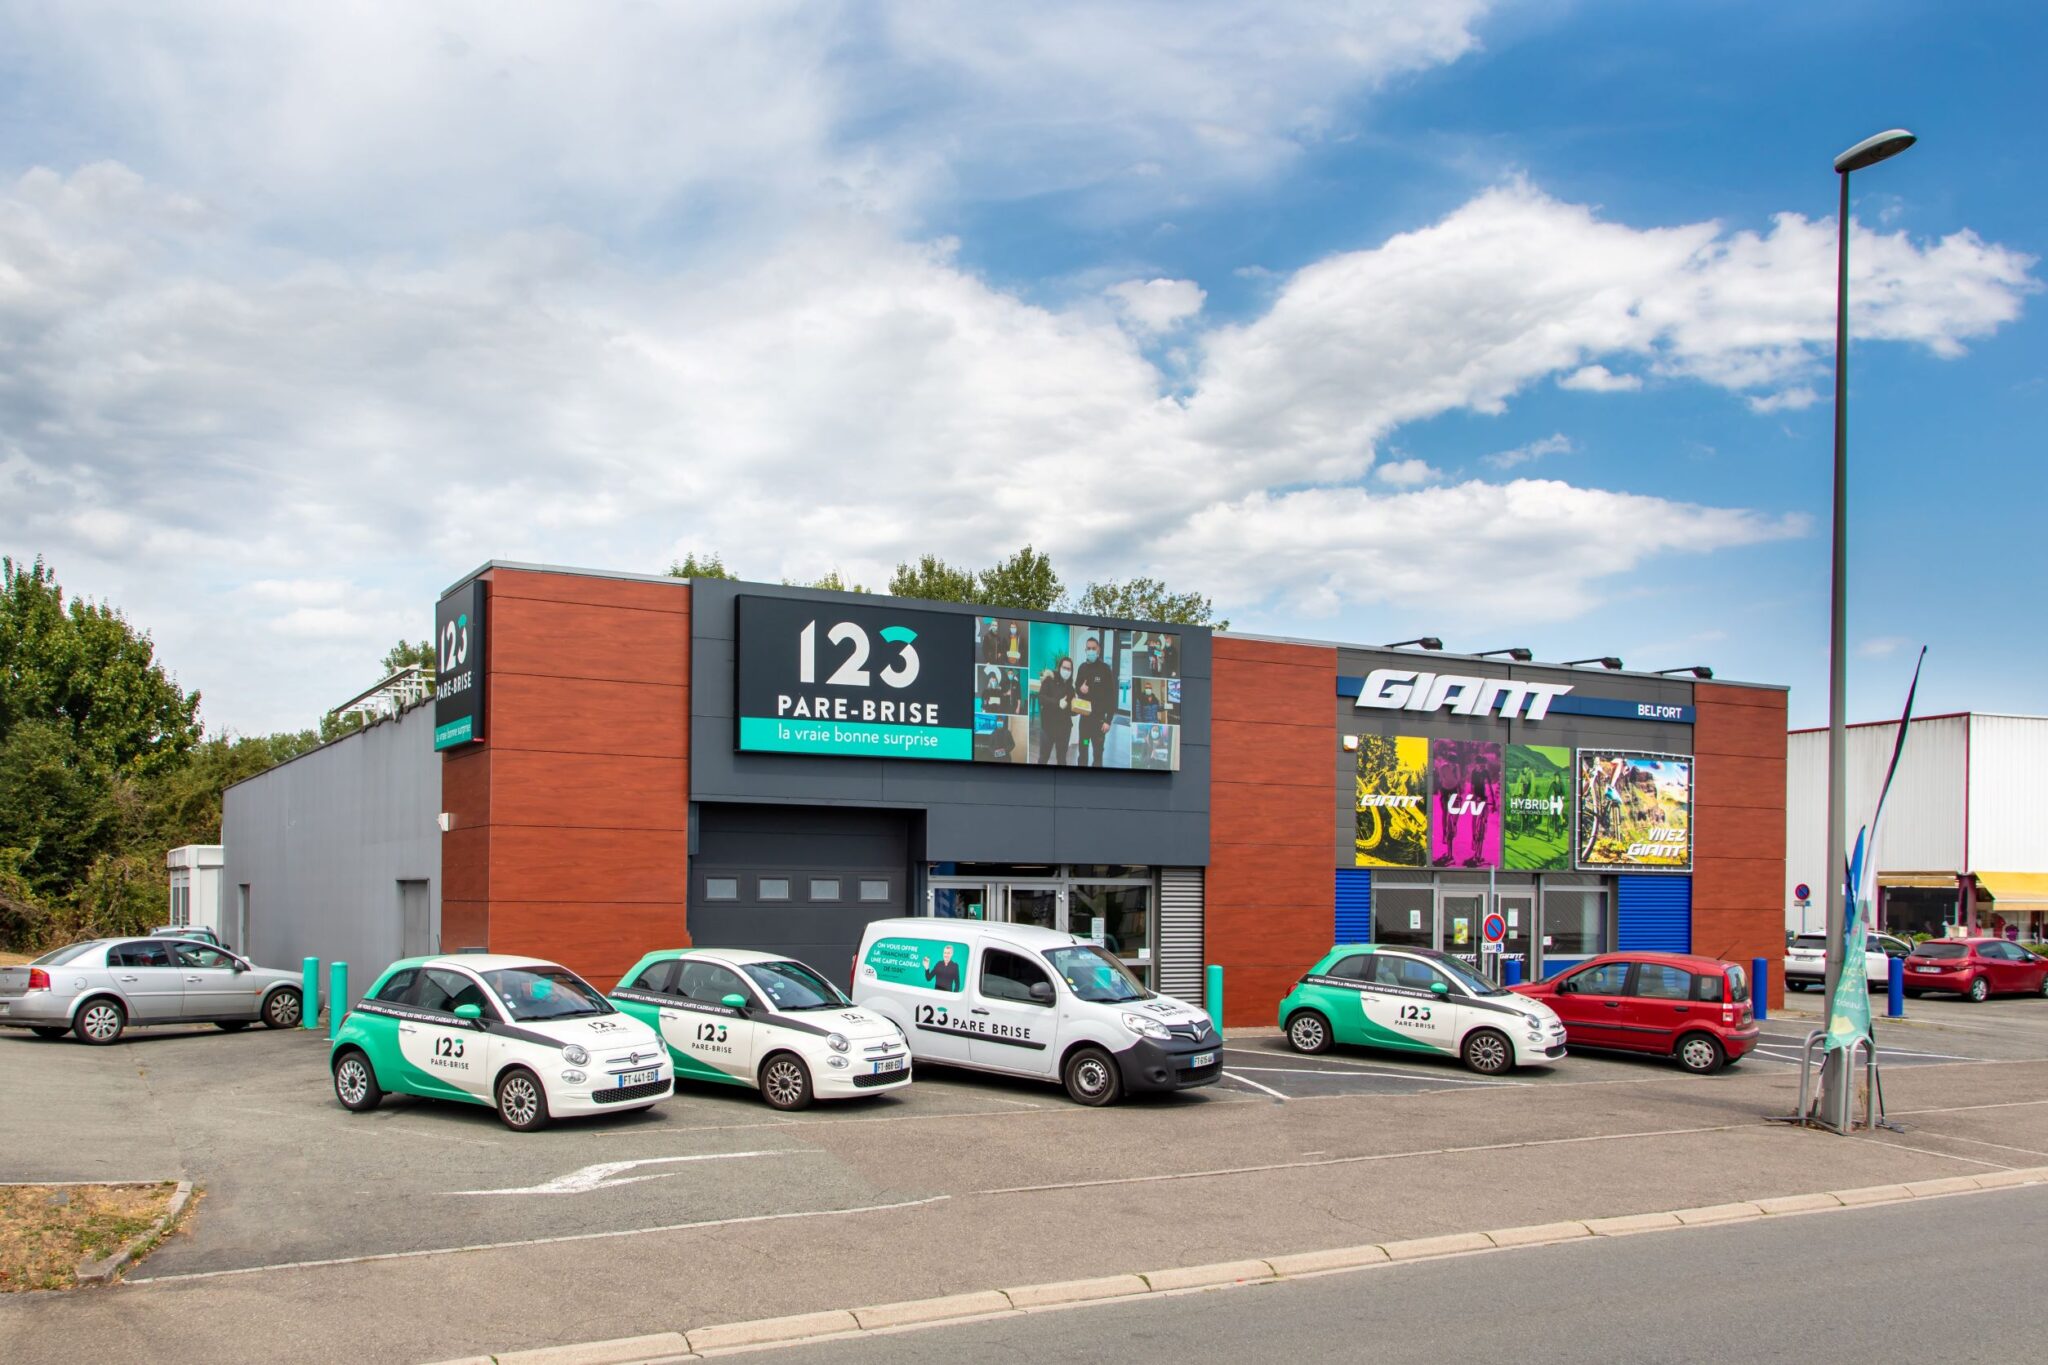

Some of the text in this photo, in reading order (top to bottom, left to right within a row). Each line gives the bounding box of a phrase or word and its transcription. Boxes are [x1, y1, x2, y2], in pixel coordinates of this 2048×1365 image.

[441, 614, 467, 673] 123
[800, 620, 920, 688] 123
[437, 671, 471, 701] PARE-BRISE
[1355, 669, 1575, 720] GIANT
[778, 695, 938, 724] PARE-BRISE
[1638, 704, 1682, 718] BELFORT
[778, 723, 938, 750] la vraie bonne surprise
[1361, 794, 1423, 807] GIANT
[1448, 794, 1486, 815] Liv
[1510, 798, 1549, 810] HYBRID
[1650, 829, 1686, 842] VIVEZ
[1627, 843, 1686, 856] GIANT
[899, 960, 920, 968] CADEAU
[645, 995, 667, 1004] FRANCHISE
[697, 1004, 714, 1012] CADEAU
[1400, 1005, 1431, 1021] 123
[916, 1005, 1030, 1039] 123 PARE BRISE
[1395, 1020, 1435, 1029] PARE-BRISE
[697, 1023, 727, 1043] 123
[436, 1037, 464, 1058] 123
[692, 1043, 732, 1053] PARE-BRISE
[431, 1058, 469, 1070] PARE-BRISE
